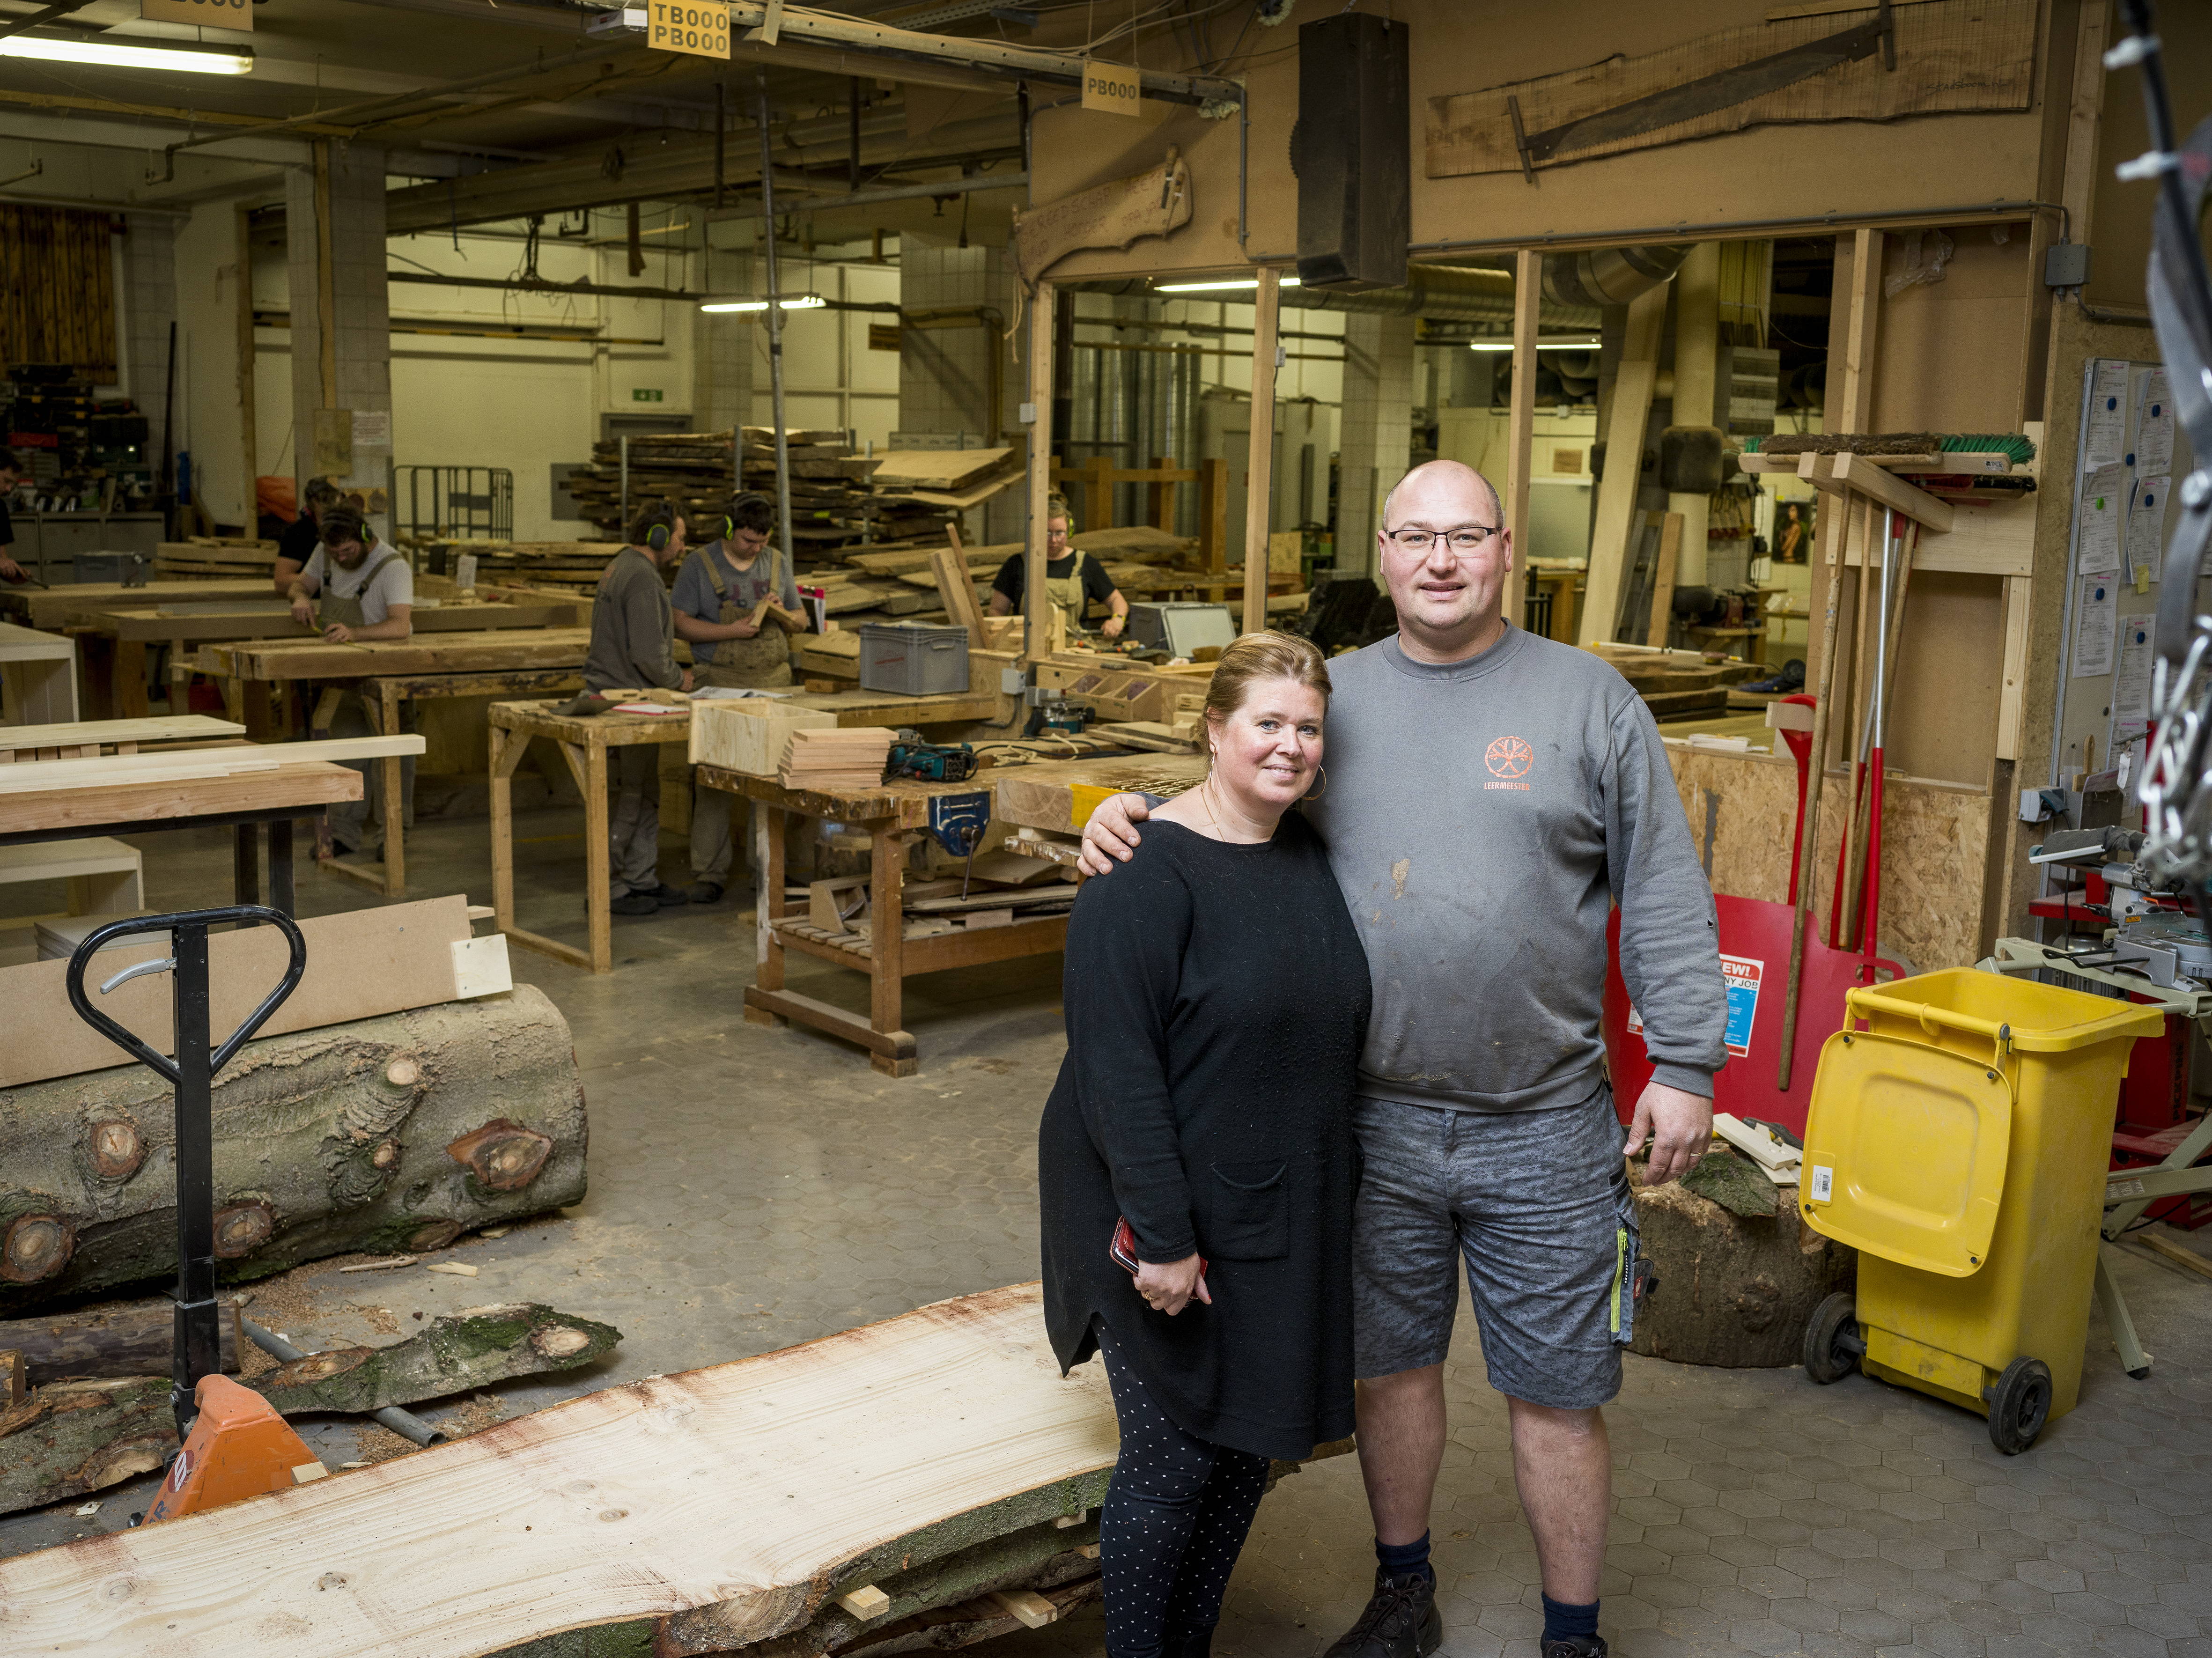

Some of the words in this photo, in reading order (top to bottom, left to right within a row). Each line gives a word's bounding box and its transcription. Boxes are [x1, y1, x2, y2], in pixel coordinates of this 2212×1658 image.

[655, 25, 727, 52] PB000
[1484, 781, 1530, 791] LEERMEESTER
[1721, 961, 1750, 977] EW!
[1725, 976, 1736, 985] NY
